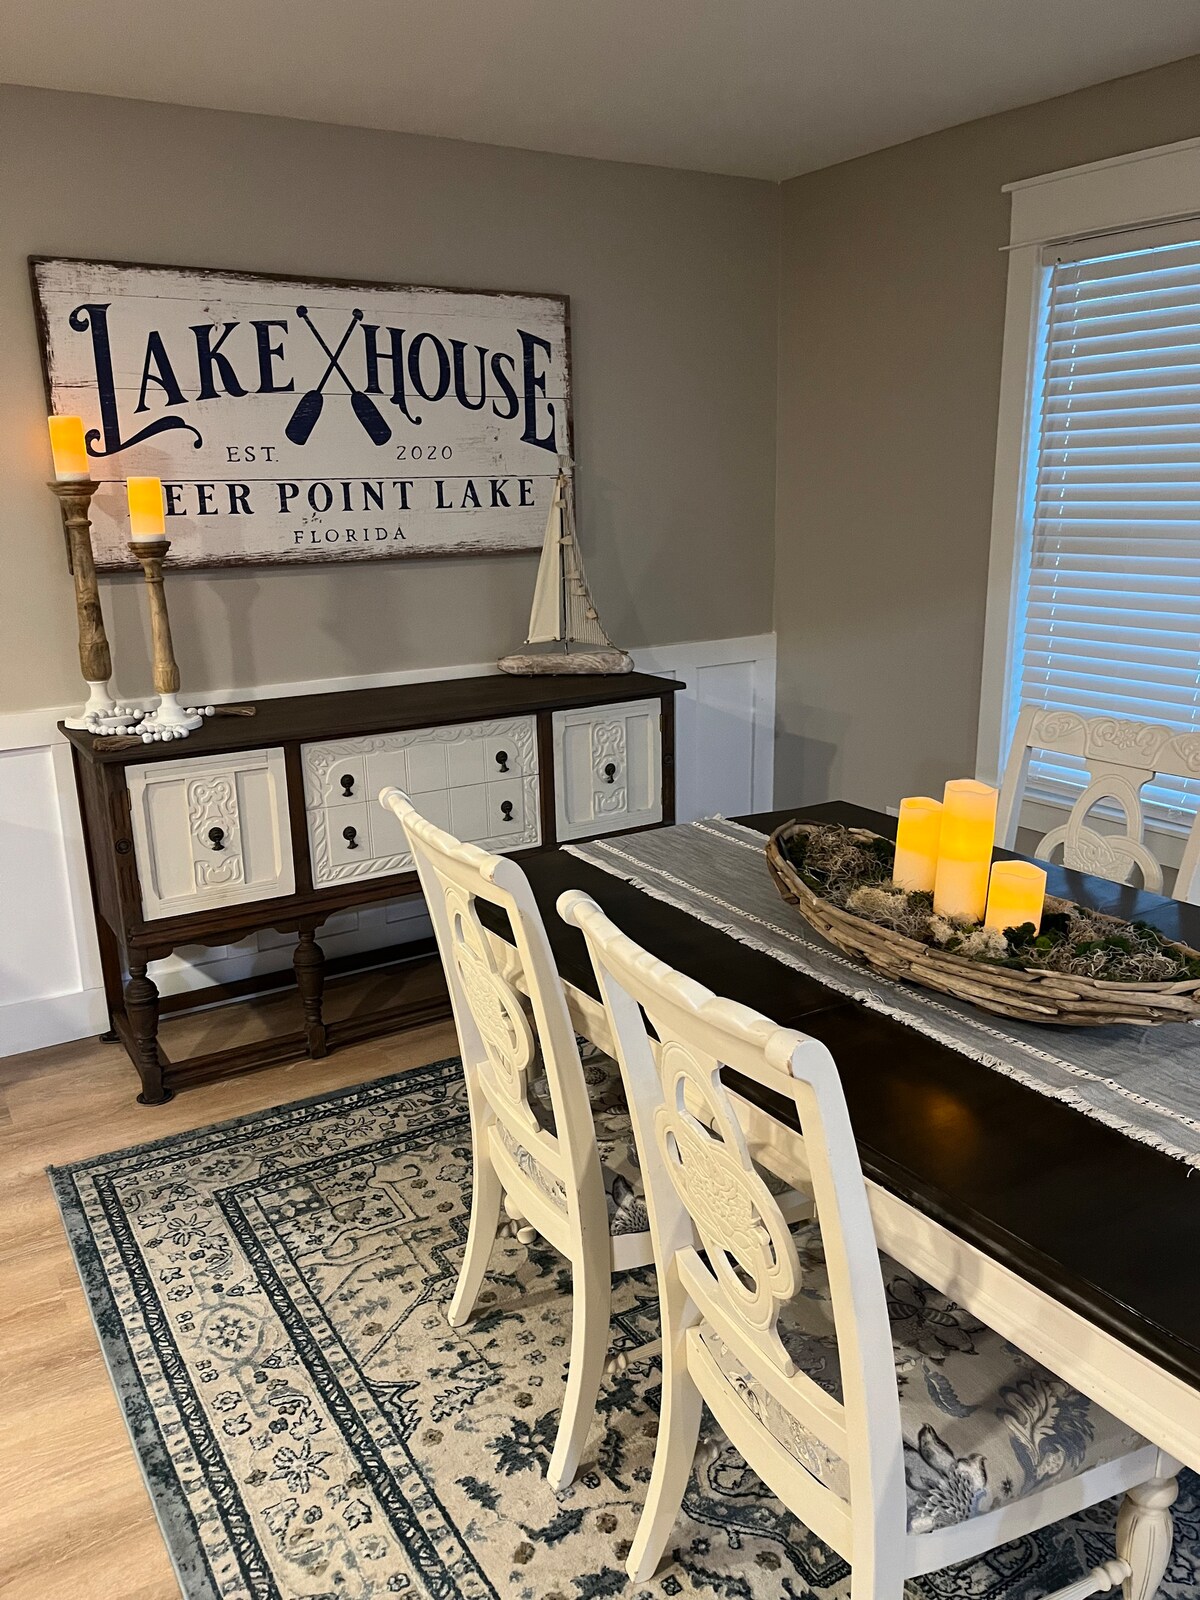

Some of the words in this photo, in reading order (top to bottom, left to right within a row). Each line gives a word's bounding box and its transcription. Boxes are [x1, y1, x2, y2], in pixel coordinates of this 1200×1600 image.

[69, 302, 295, 458] LAKE
[359, 323, 558, 453] HOUSE
[226, 446, 280, 463] EST.
[396, 445, 453, 461] 2020
[124, 484, 255, 516] EER
[276, 481, 414, 514] POINT
[434, 478, 535, 510] LAKE
[294, 527, 407, 544] FLORIDA
